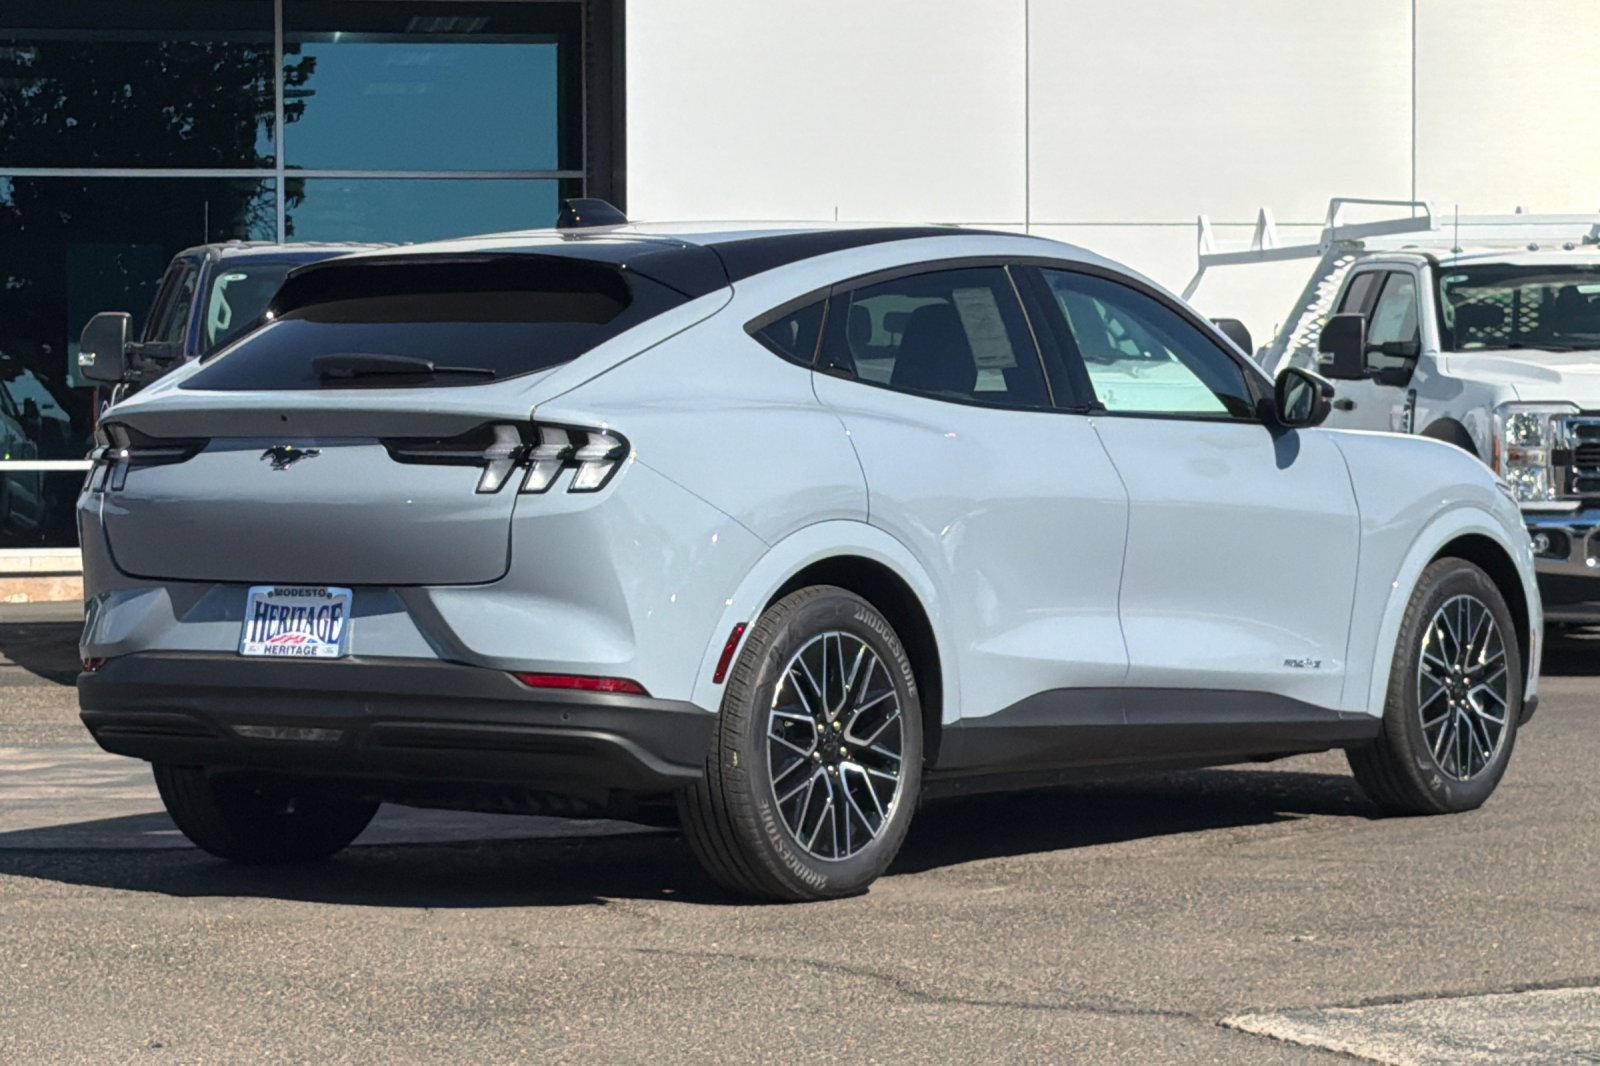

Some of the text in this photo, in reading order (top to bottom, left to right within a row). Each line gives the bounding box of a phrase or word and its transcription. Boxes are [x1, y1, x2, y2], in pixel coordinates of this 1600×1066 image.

[273, 588, 326, 597] MODESTO
[251, 600, 343, 644] HERITAGE
[264, 645, 318, 655] HERITAGE
[854, 606, 917, 698] BRIDGESTONE
[760, 799, 828, 890] BRIDGESTONE
